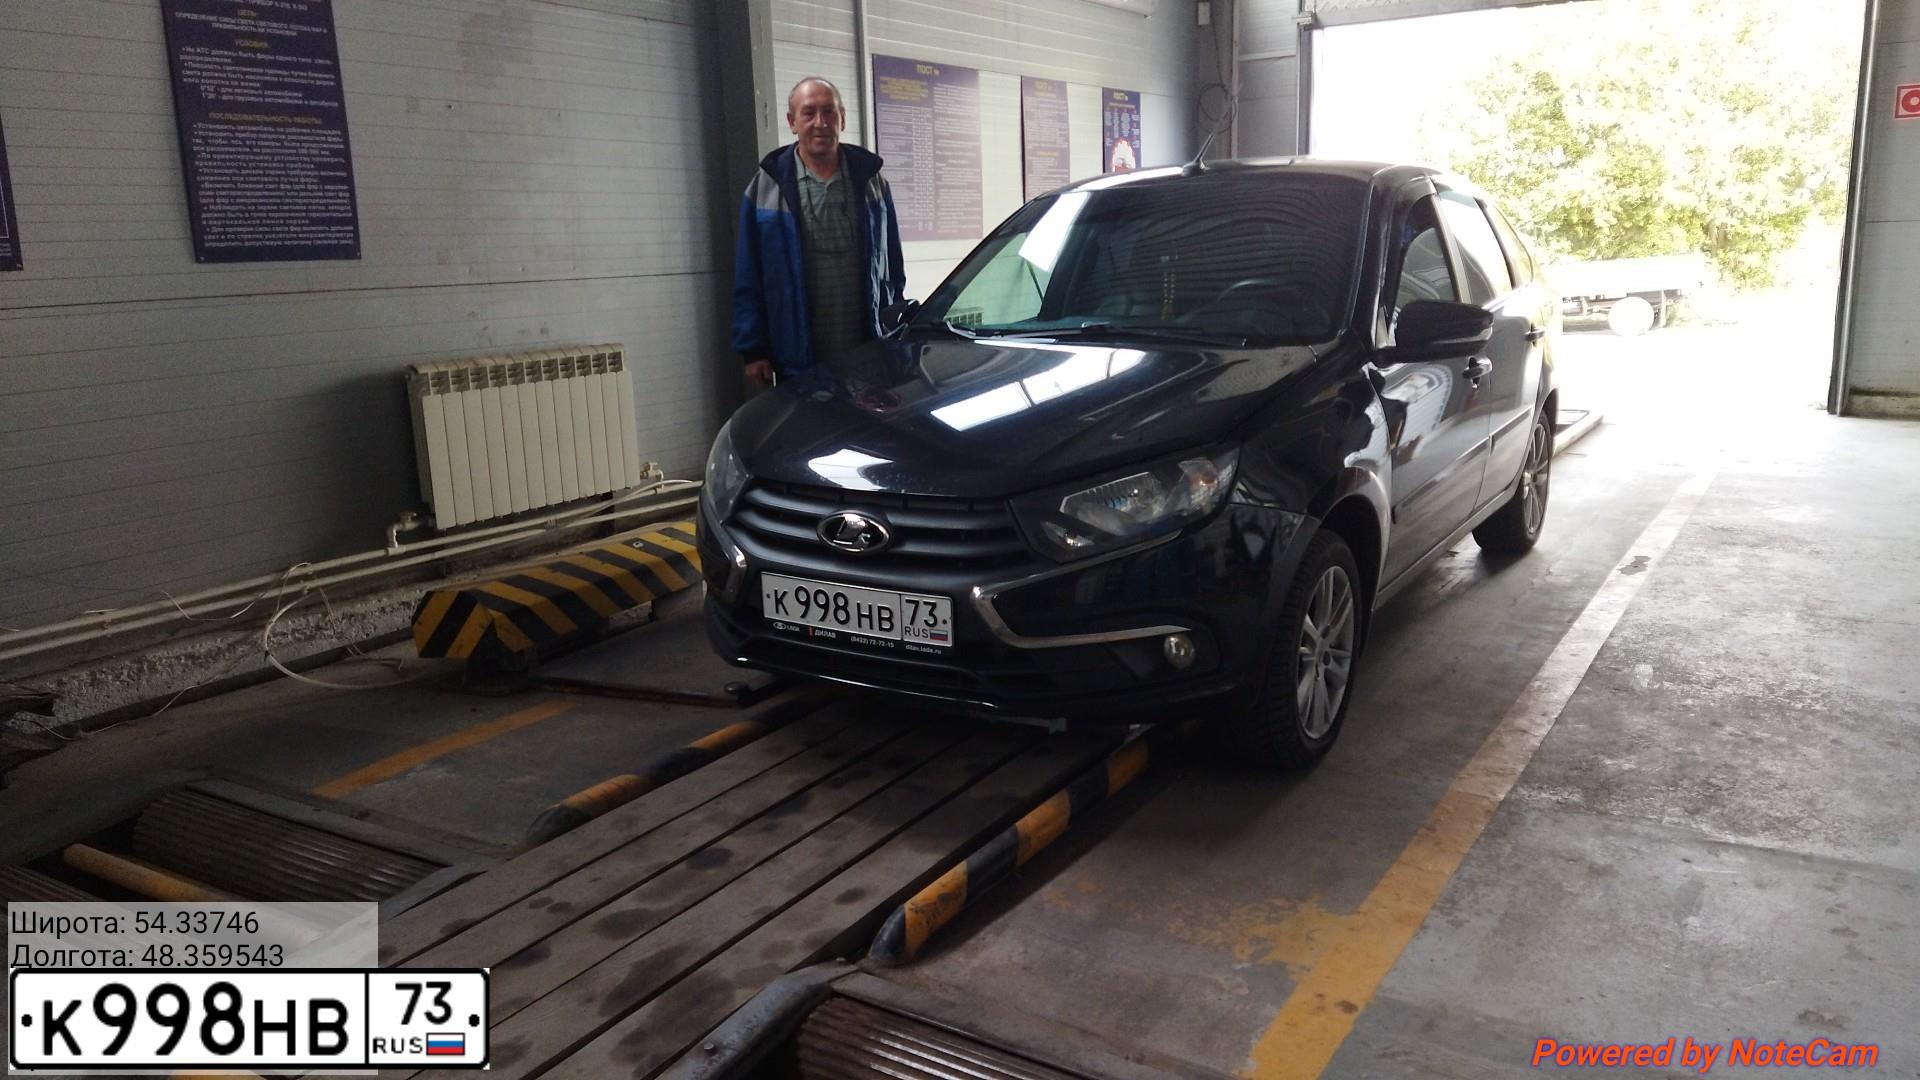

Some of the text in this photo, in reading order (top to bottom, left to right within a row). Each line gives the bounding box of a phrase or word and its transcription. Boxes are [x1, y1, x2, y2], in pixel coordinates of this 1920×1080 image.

[916, 63, 933, 74] ПОСТ
[773, 585, 938, 633] К998НВ 73
[814, 629, 837, 639] ДИЛАВ
[904, 626, 929, 639] RUS
